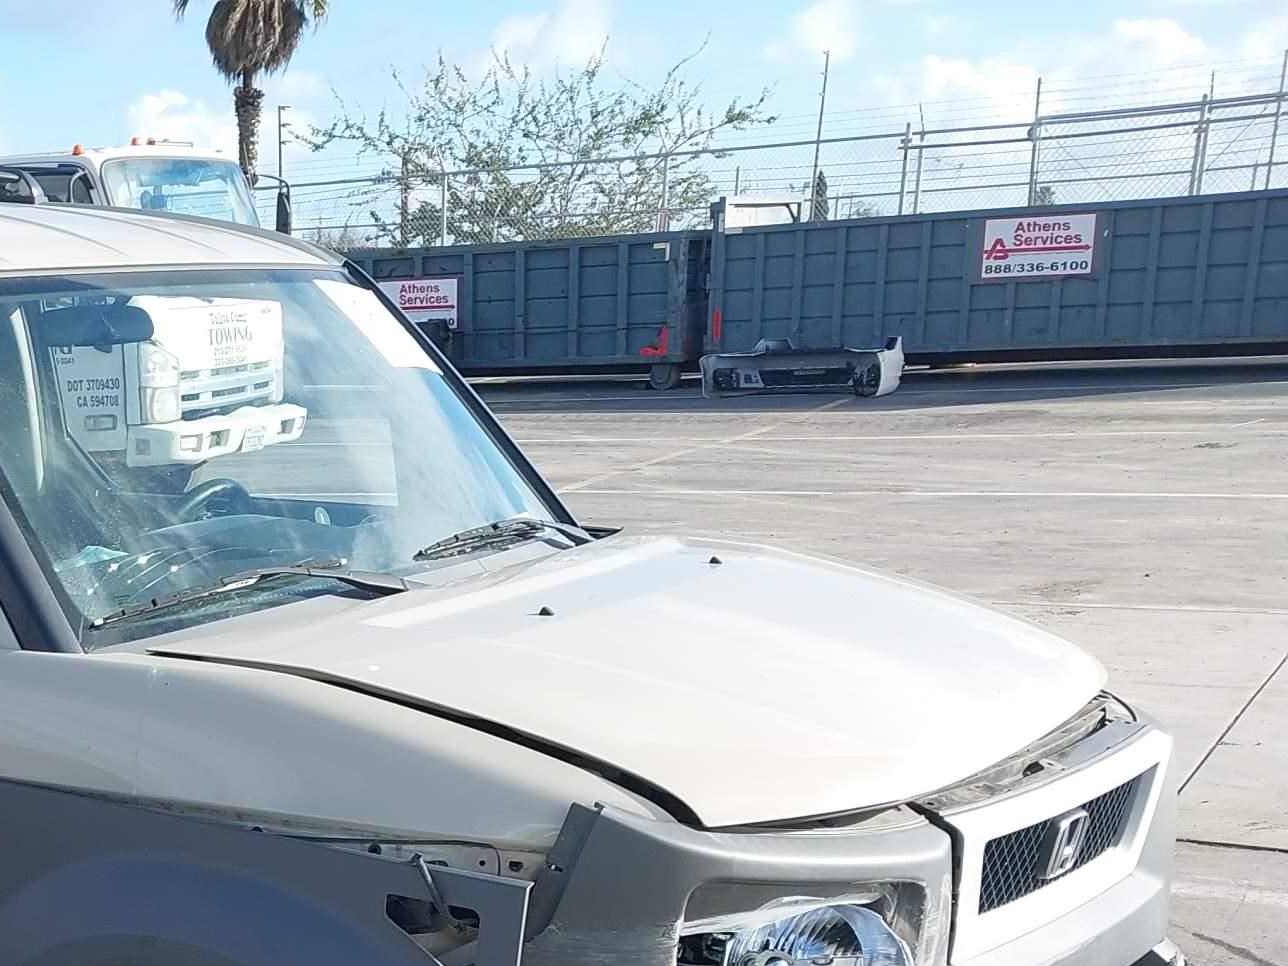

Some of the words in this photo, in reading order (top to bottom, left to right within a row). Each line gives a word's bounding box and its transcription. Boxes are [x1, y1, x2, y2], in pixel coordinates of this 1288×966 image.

[1014, 221, 1071, 233] Athens
[1013, 233, 1083, 247] Services
[984, 260, 1089, 275] 888/336-6100
[399, 284, 441, 294] Athens
[399, 294, 449, 305] Services
[208, 326, 253, 346] TOWING
[67, 379, 84, 393] DOT
[85, 377, 120, 391] 3709430
[77, 395, 89, 408] CA
[90, 394, 120, 408] 594708
